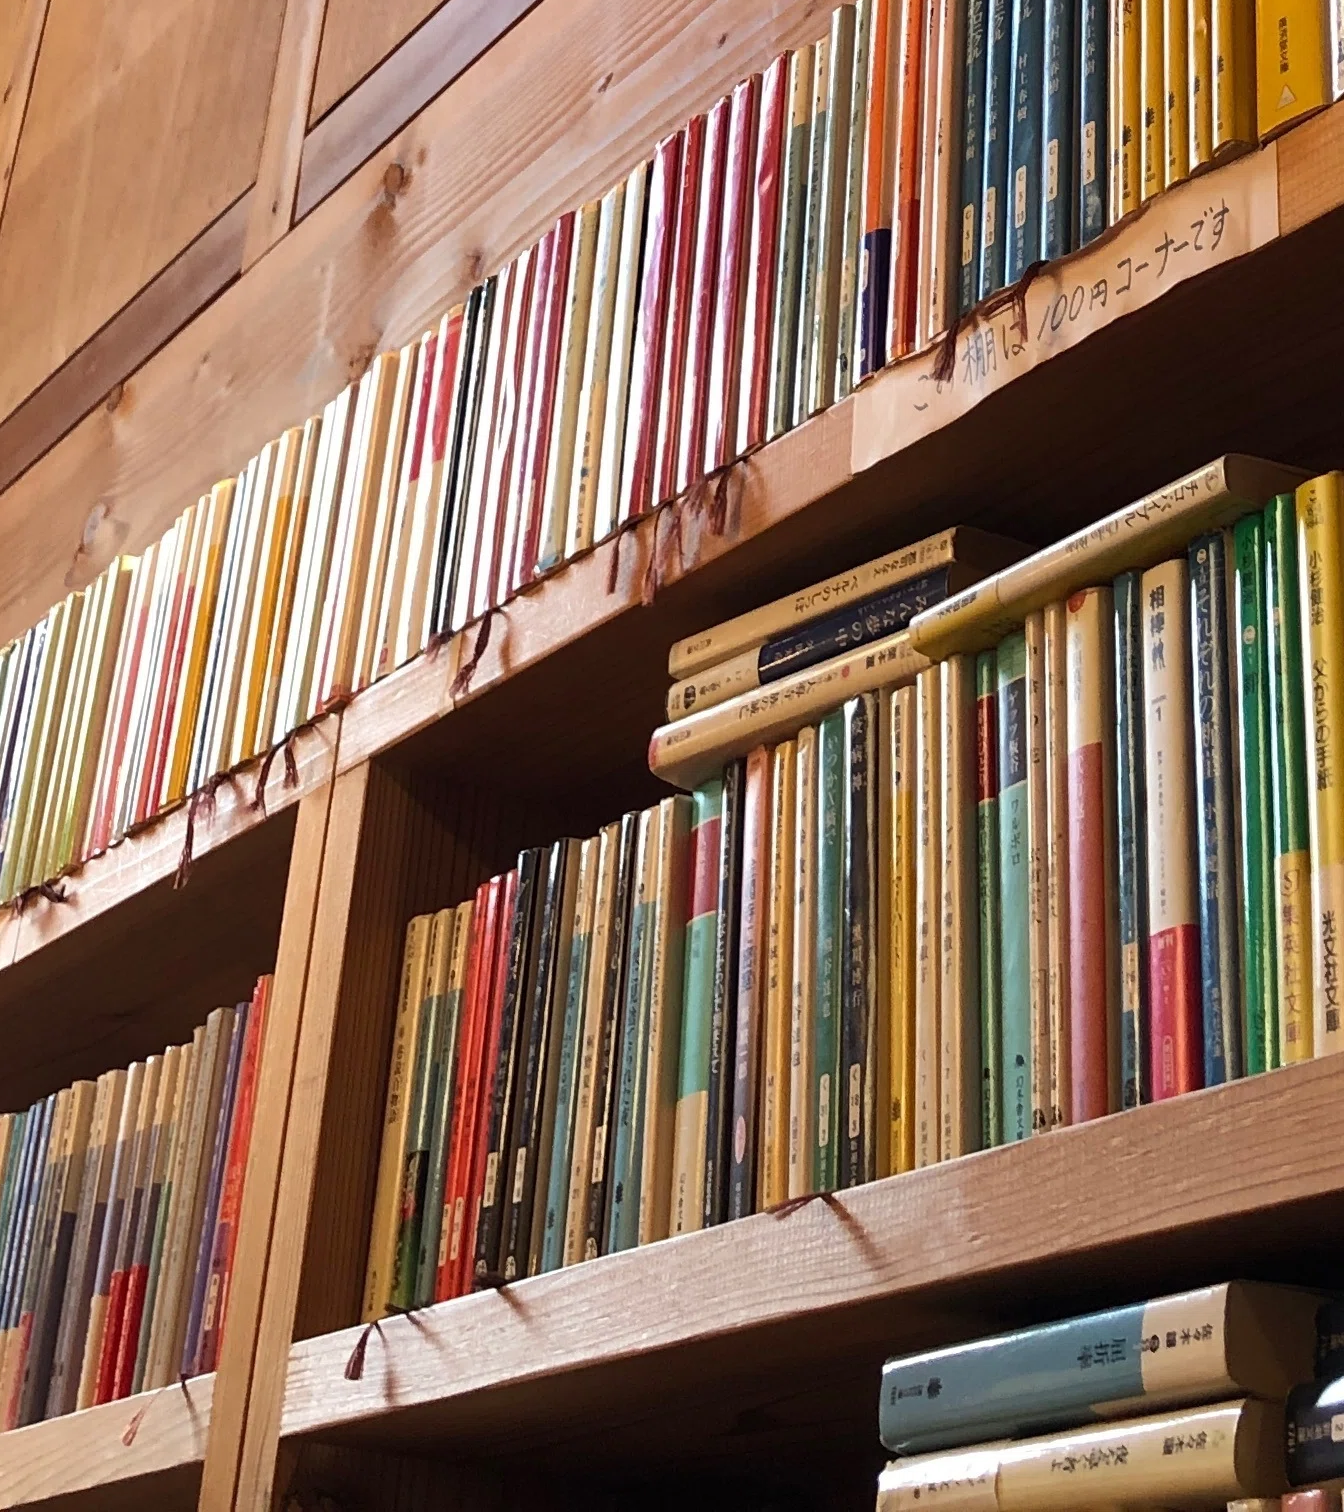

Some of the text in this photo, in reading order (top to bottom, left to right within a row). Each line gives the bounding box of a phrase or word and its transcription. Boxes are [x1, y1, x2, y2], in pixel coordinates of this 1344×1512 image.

[913, 197, 1231, 412] こ棚は100円コーナーです
[834, 594, 929, 648] みんな夢の中
[1311, 658, 1334, 793] 父からの手紙
[1282, 904, 1299, 1045] 集英社文庫
[1321, 909, 1341, 1035] 光文社文庫
[1076, 1336, 1128, 1370] 屈折率
[1164, 1321, 1214, 1350] 佐々木譲
[1161, 1429, 1210, 1457] 佐々木譲
